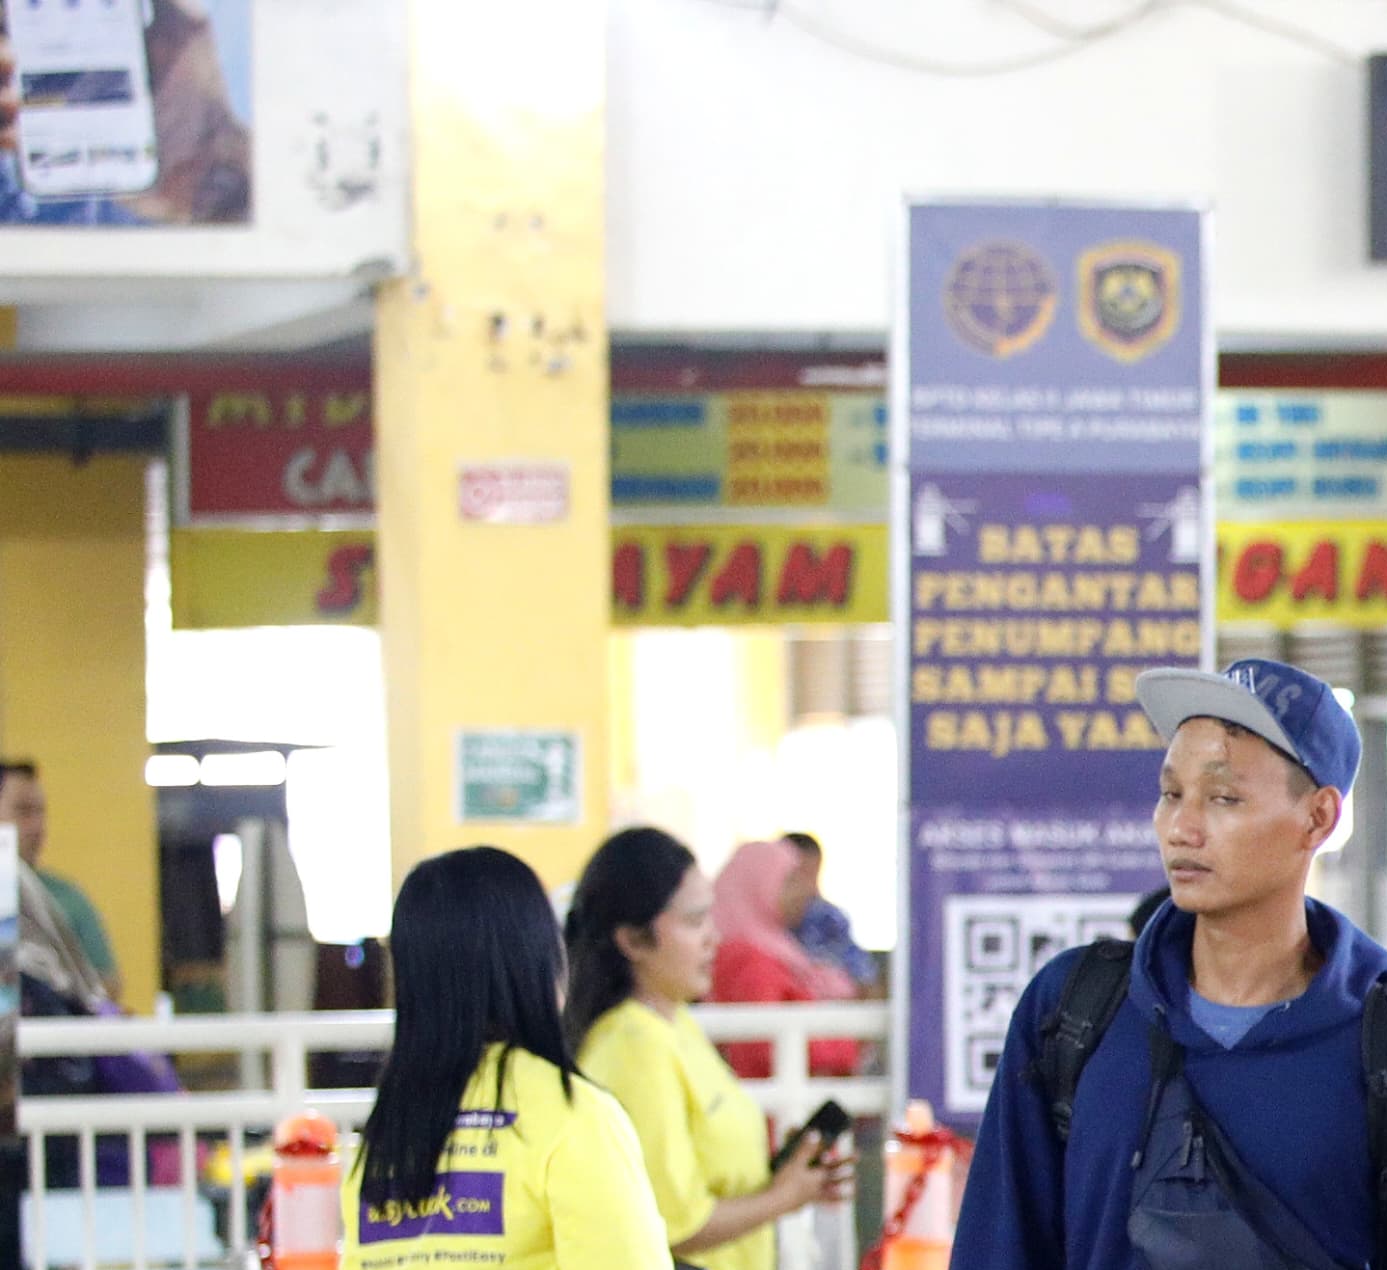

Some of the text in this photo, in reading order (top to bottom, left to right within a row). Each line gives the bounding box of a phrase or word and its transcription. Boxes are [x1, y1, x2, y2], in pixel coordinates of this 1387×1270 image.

[979, 525, 1138, 563] BATAS
[913, 617, 1200, 658] PENUMPANG
[911, 664, 1101, 704] SAMPAI
[926, 710, 1049, 758] SAJA
